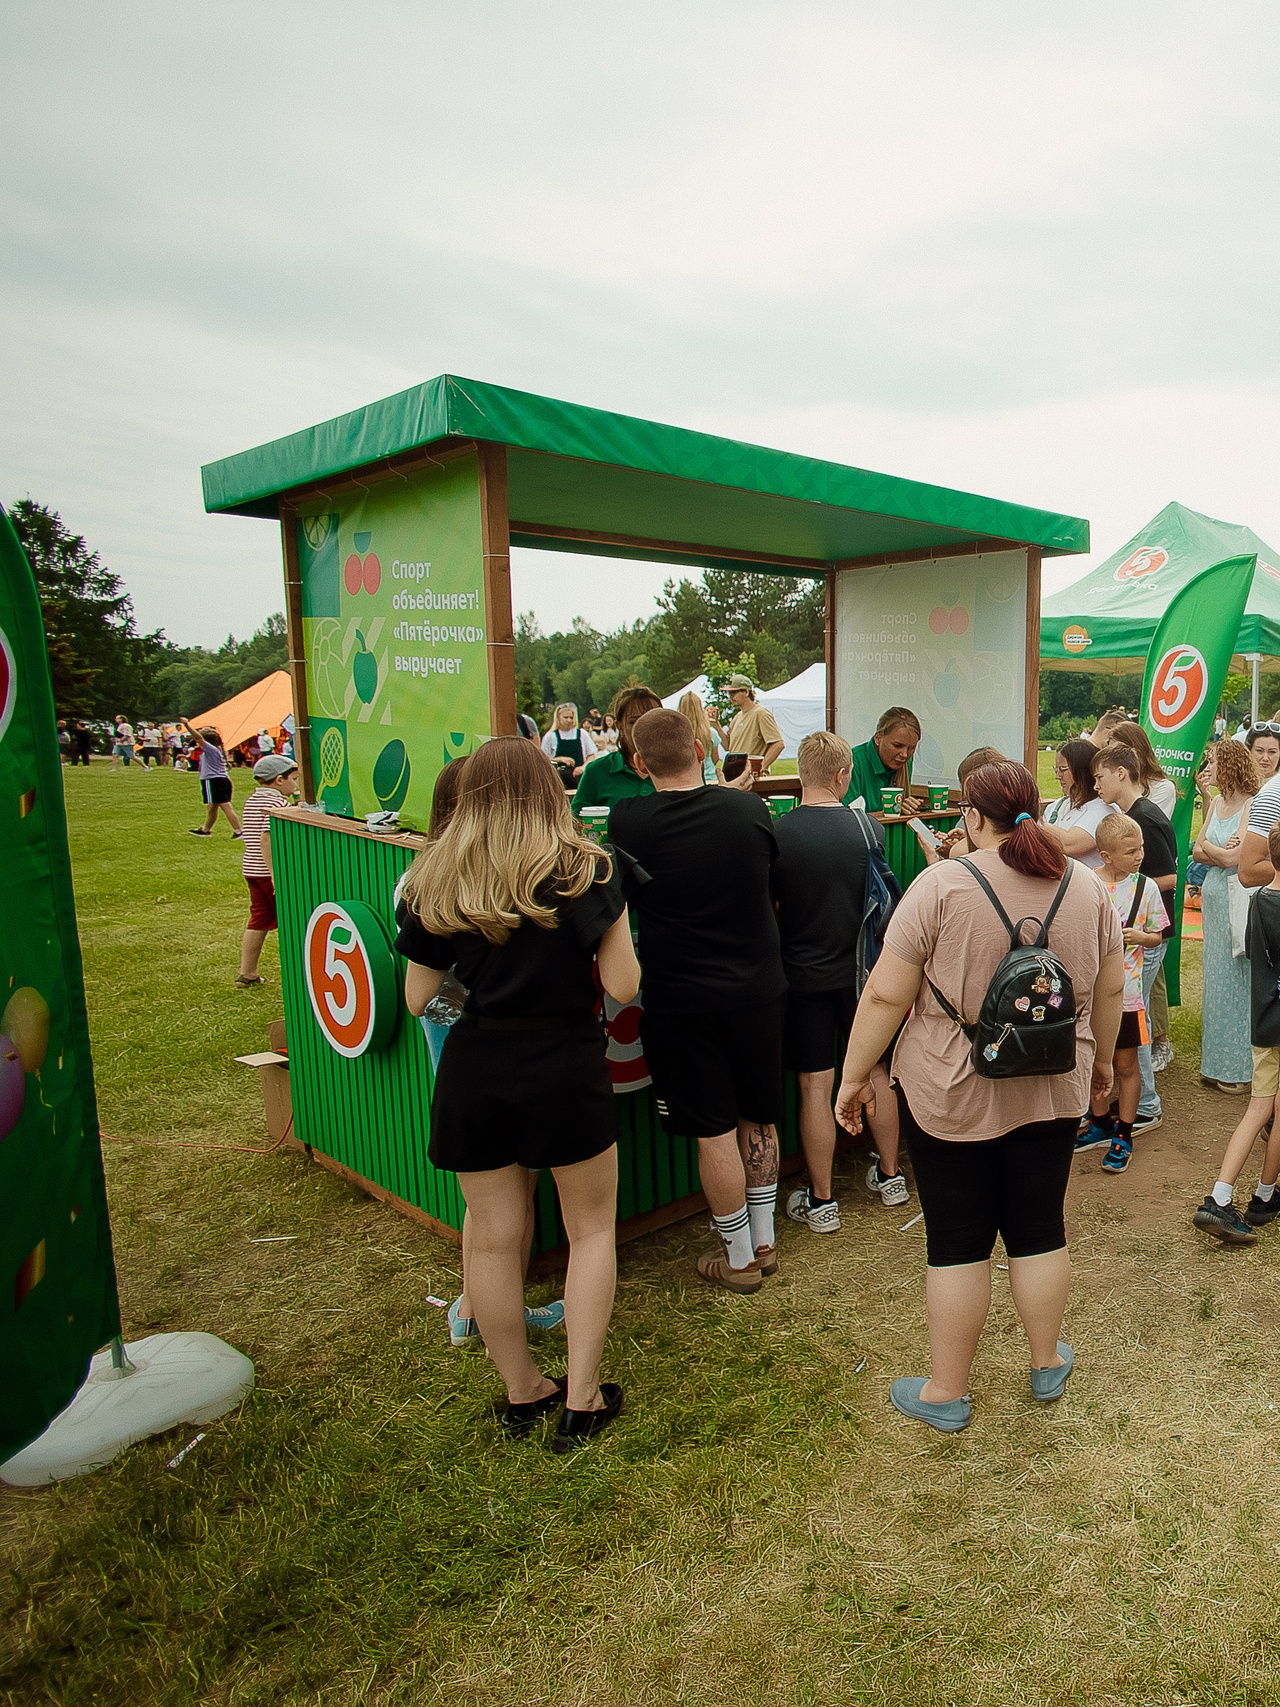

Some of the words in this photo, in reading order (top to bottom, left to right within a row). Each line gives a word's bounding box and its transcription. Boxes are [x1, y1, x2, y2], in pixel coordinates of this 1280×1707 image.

[392, 560, 431, 583] Спорт
[392, 588, 479, 610] объединяет!
[393, 620, 484, 647] «Пятёрочка»
[395, 655, 462, 678] выручает
[1153, 745, 1195, 762] ёрочка
